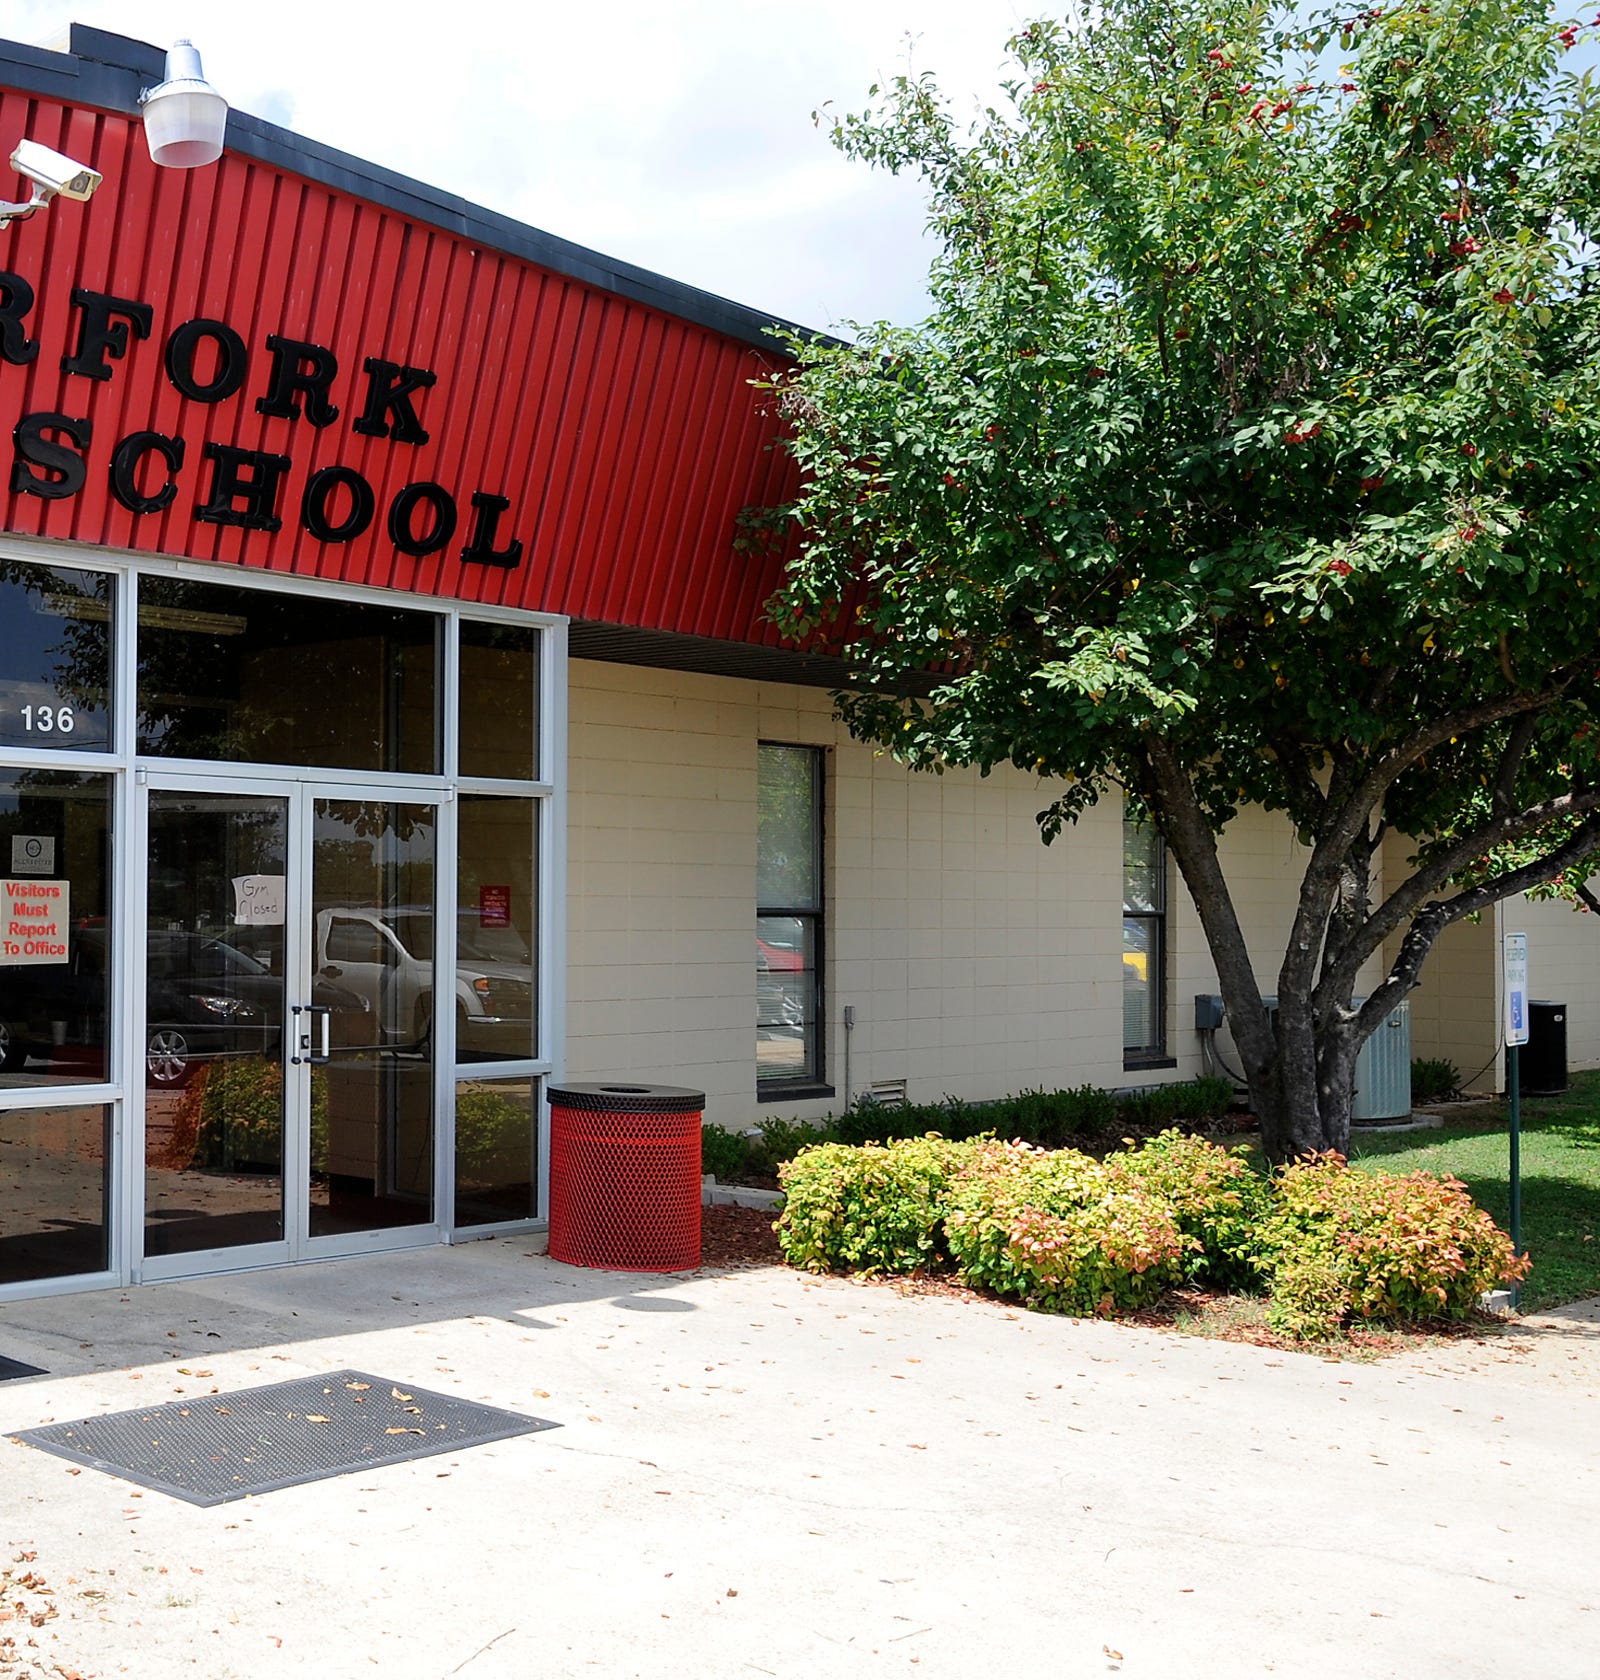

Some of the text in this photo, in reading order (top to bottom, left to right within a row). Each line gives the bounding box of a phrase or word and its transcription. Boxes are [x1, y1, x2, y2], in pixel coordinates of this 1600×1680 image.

[9, 410, 524, 569] SCHOOL
[20, 705, 75, 733] 136
[6, 883, 61, 898] Visitors
[242, 878, 269, 898] Gym
[13, 902, 49, 917] Must
[9, 921, 57, 938] Report
[3, 941, 66, 956] To Office
